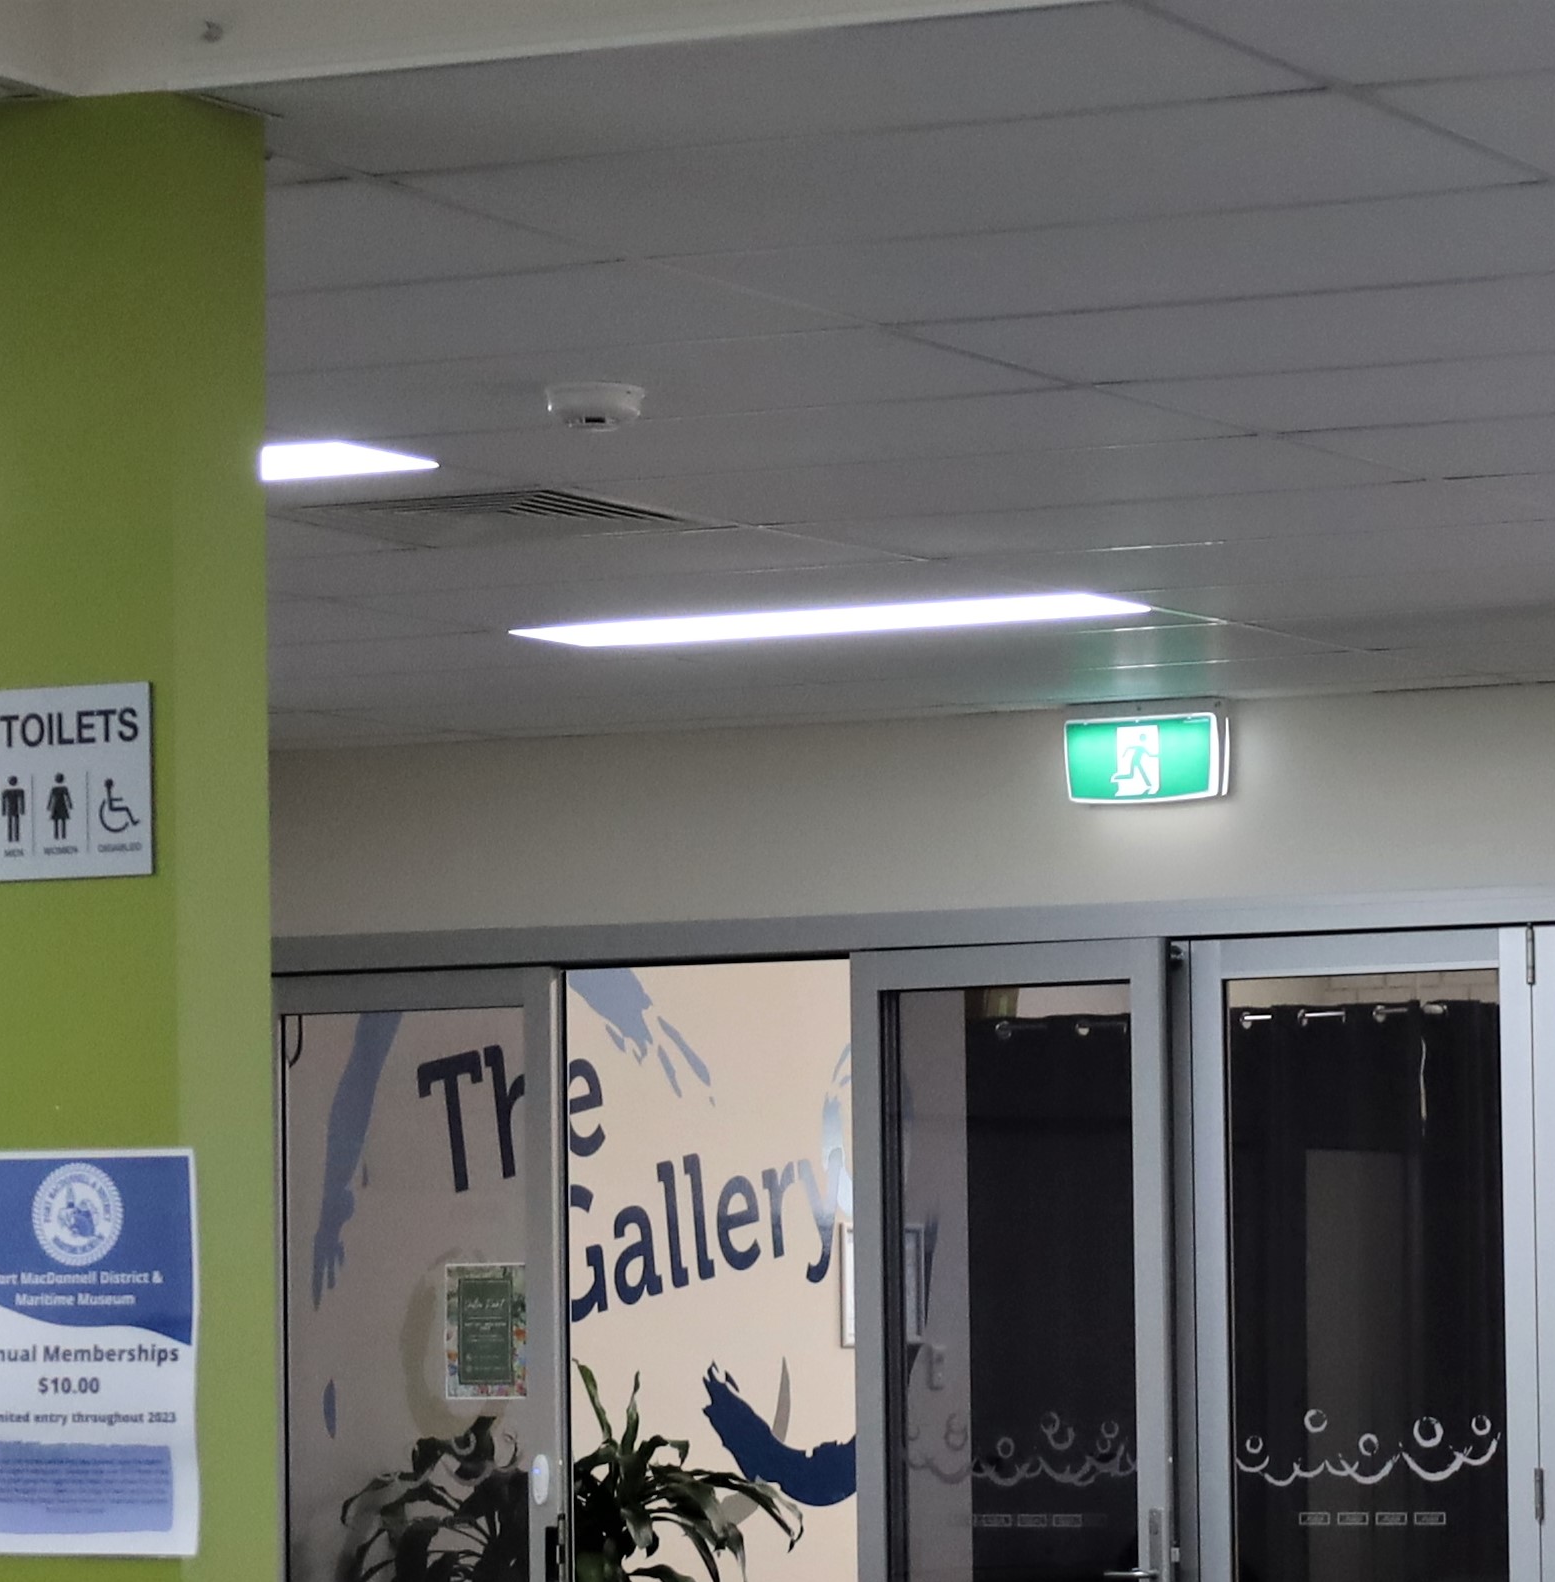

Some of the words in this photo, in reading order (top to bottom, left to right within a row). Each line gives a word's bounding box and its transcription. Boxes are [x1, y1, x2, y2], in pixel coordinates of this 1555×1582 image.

[0, 707, 139, 748] TOILETS
[418, 1045, 605, 1192] The
[569, 1147, 843, 1323] Gallery
[20, 1271, 96, 1285] MacDonnell
[100, 1271, 149, 1284] District
[152, 1270, 163, 1284] &
[15, 1293, 74, 1306] Maritime
[77, 1293, 136, 1306] Museum
[43, 1344, 179, 1367] Memberships
[38, 1377, 100, 1394] $10.00
[33, 1413, 67, 1426] entry
[71, 1411, 144, 1426] throughout
